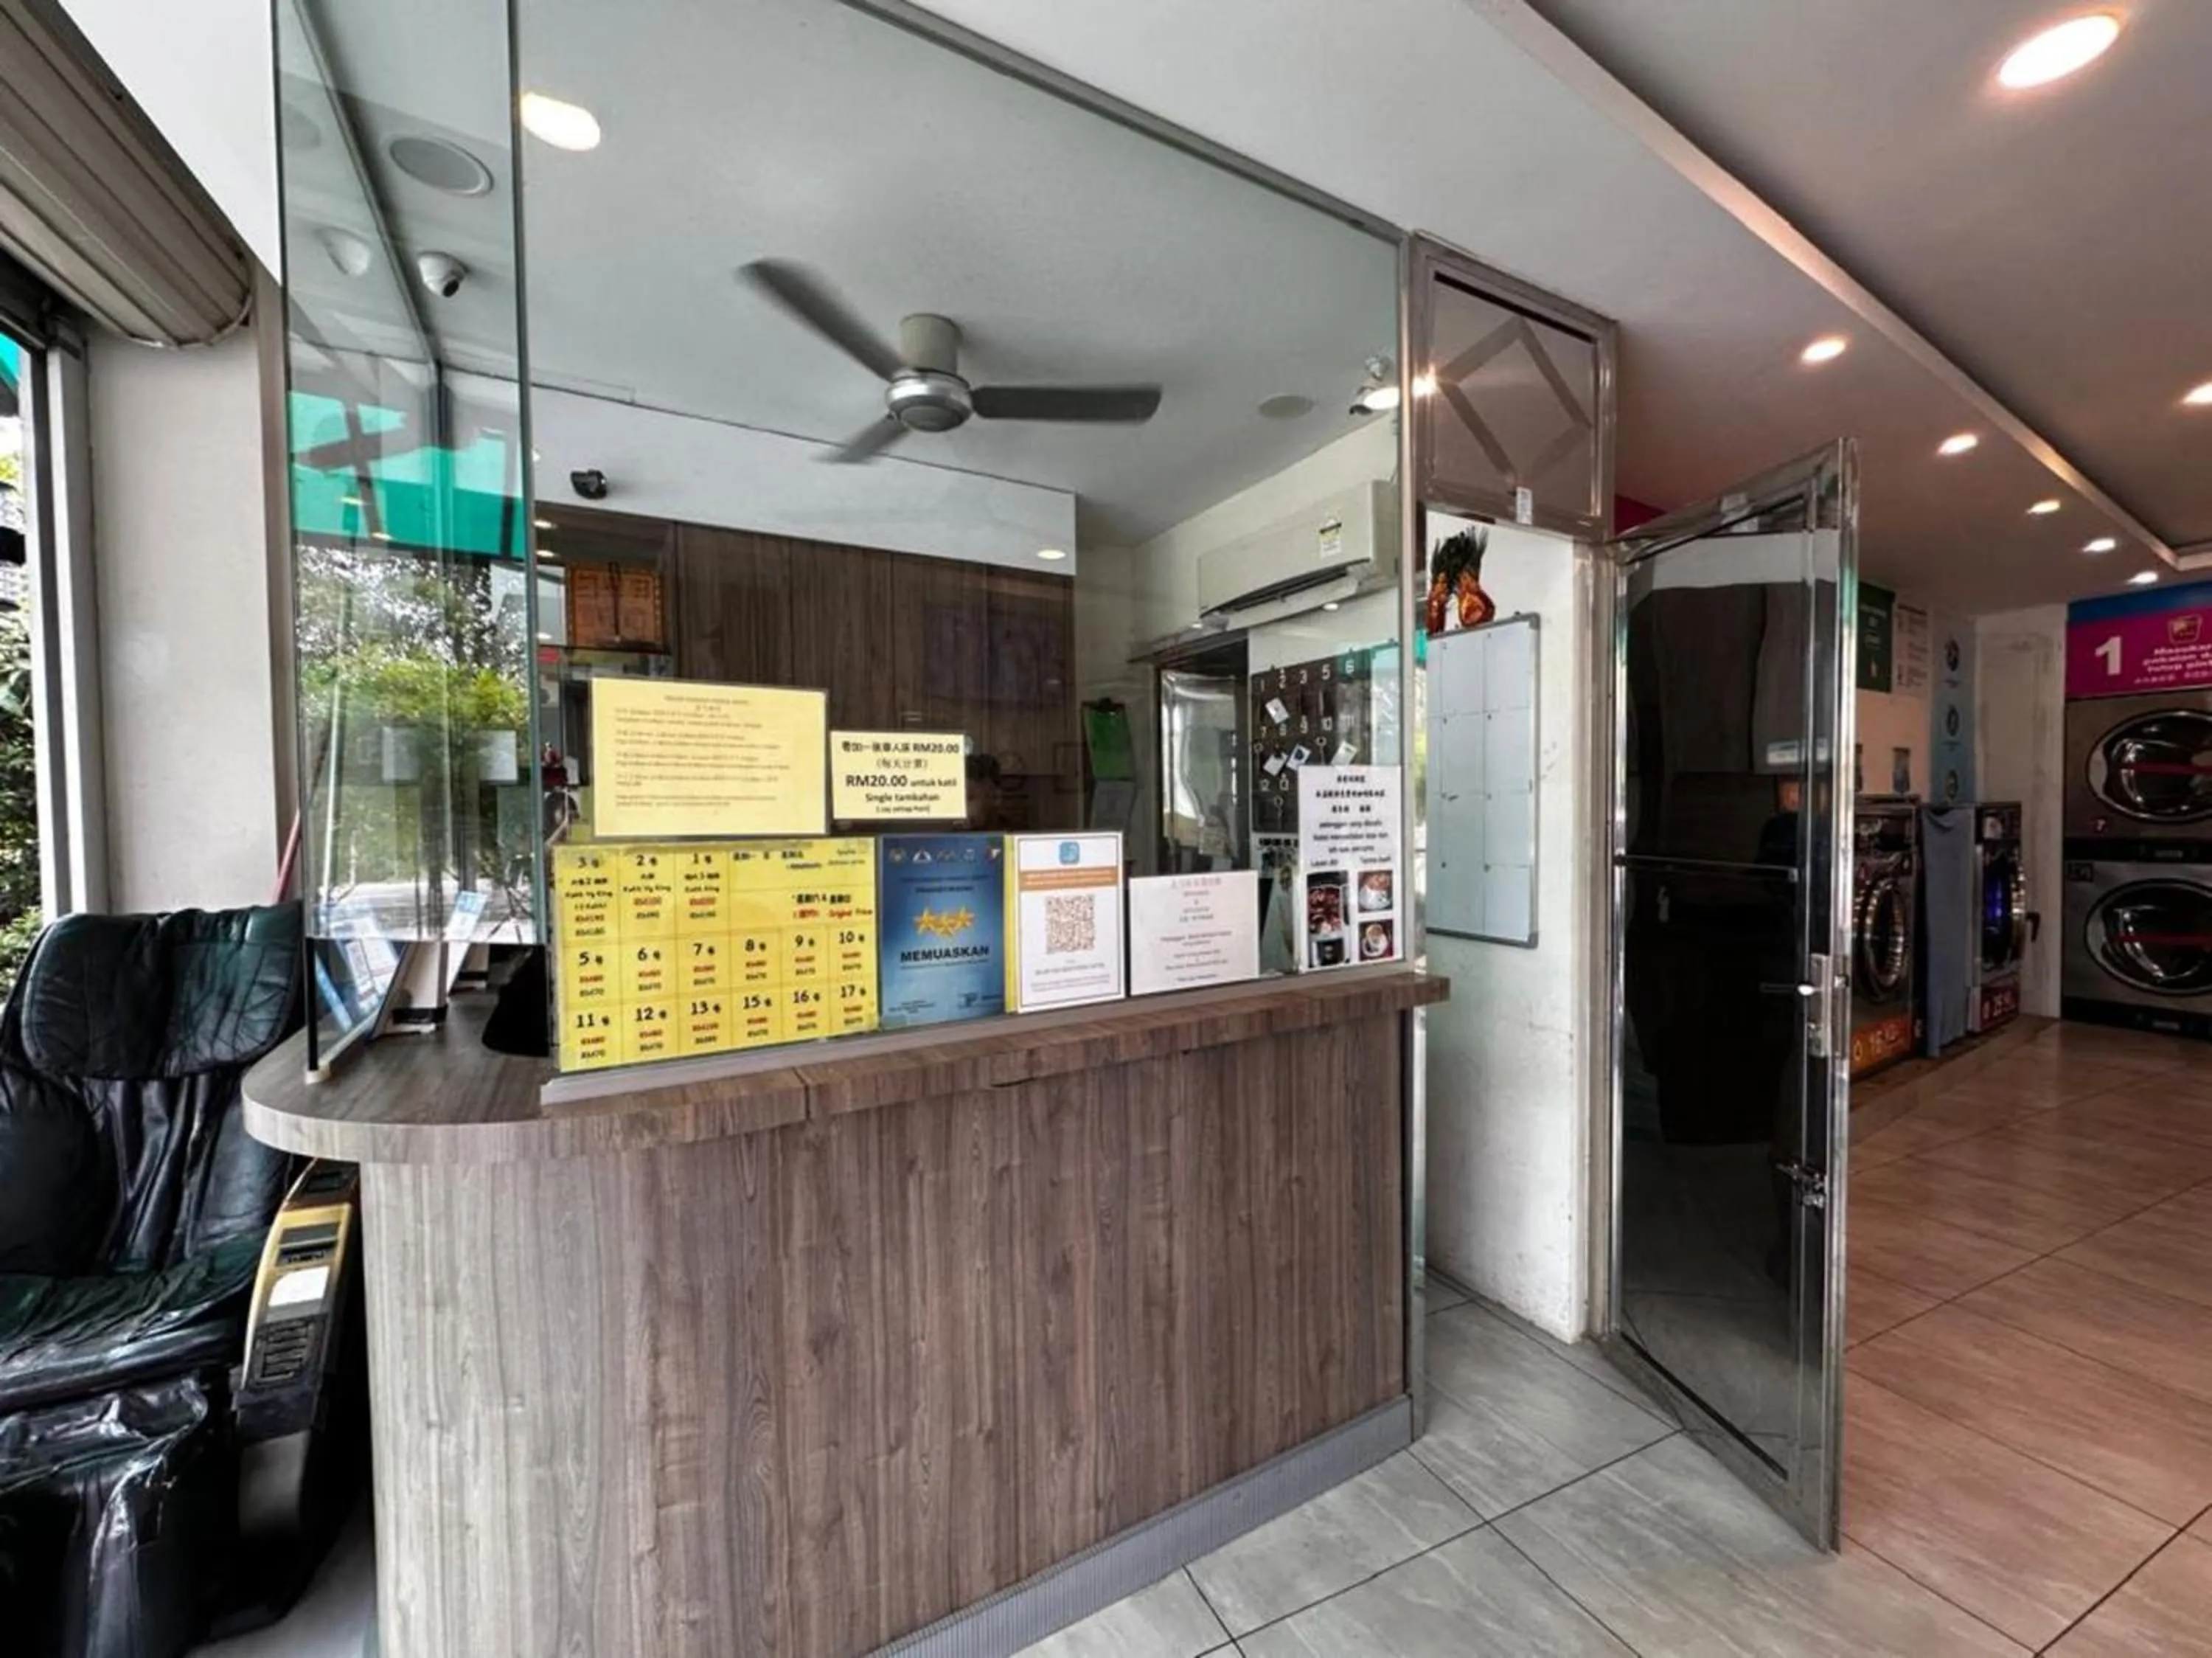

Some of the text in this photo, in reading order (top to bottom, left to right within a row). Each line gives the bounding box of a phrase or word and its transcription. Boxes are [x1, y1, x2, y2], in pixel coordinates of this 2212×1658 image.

[2096, 635, 2122, 676] 1
[1299, 670, 1308, 684] 3
[1321, 664, 1331, 681] 5
[1345, 659, 1354, 674] 6
[913, 743, 959, 754] RM20.00
[846, 774, 908, 787] RM20.00
[910, 779, 935, 787] untuk
[865, 794, 893, 802] Single
[578, 857, 587, 868] 3
[636, 855, 645, 866] 2
[693, 853, 699, 864] 1
[795, 934, 804, 947] 9
[839, 931, 855, 944] 10
[693, 943, 703, 956] 7
[745, 939, 754, 951] 8
[579, 951, 589, 966] 5
[637, 948, 647, 961] 6
[900, 946, 990, 963] MEMUASKAN
[793, 990, 809, 1003] 16
[841, 985, 855, 998] 17
[691, 1001, 709, 1016] 13
[743, 996, 760, 1010] 15
[577, 1013, 595, 1028] 11
[636, 1007, 653, 1021] 12
